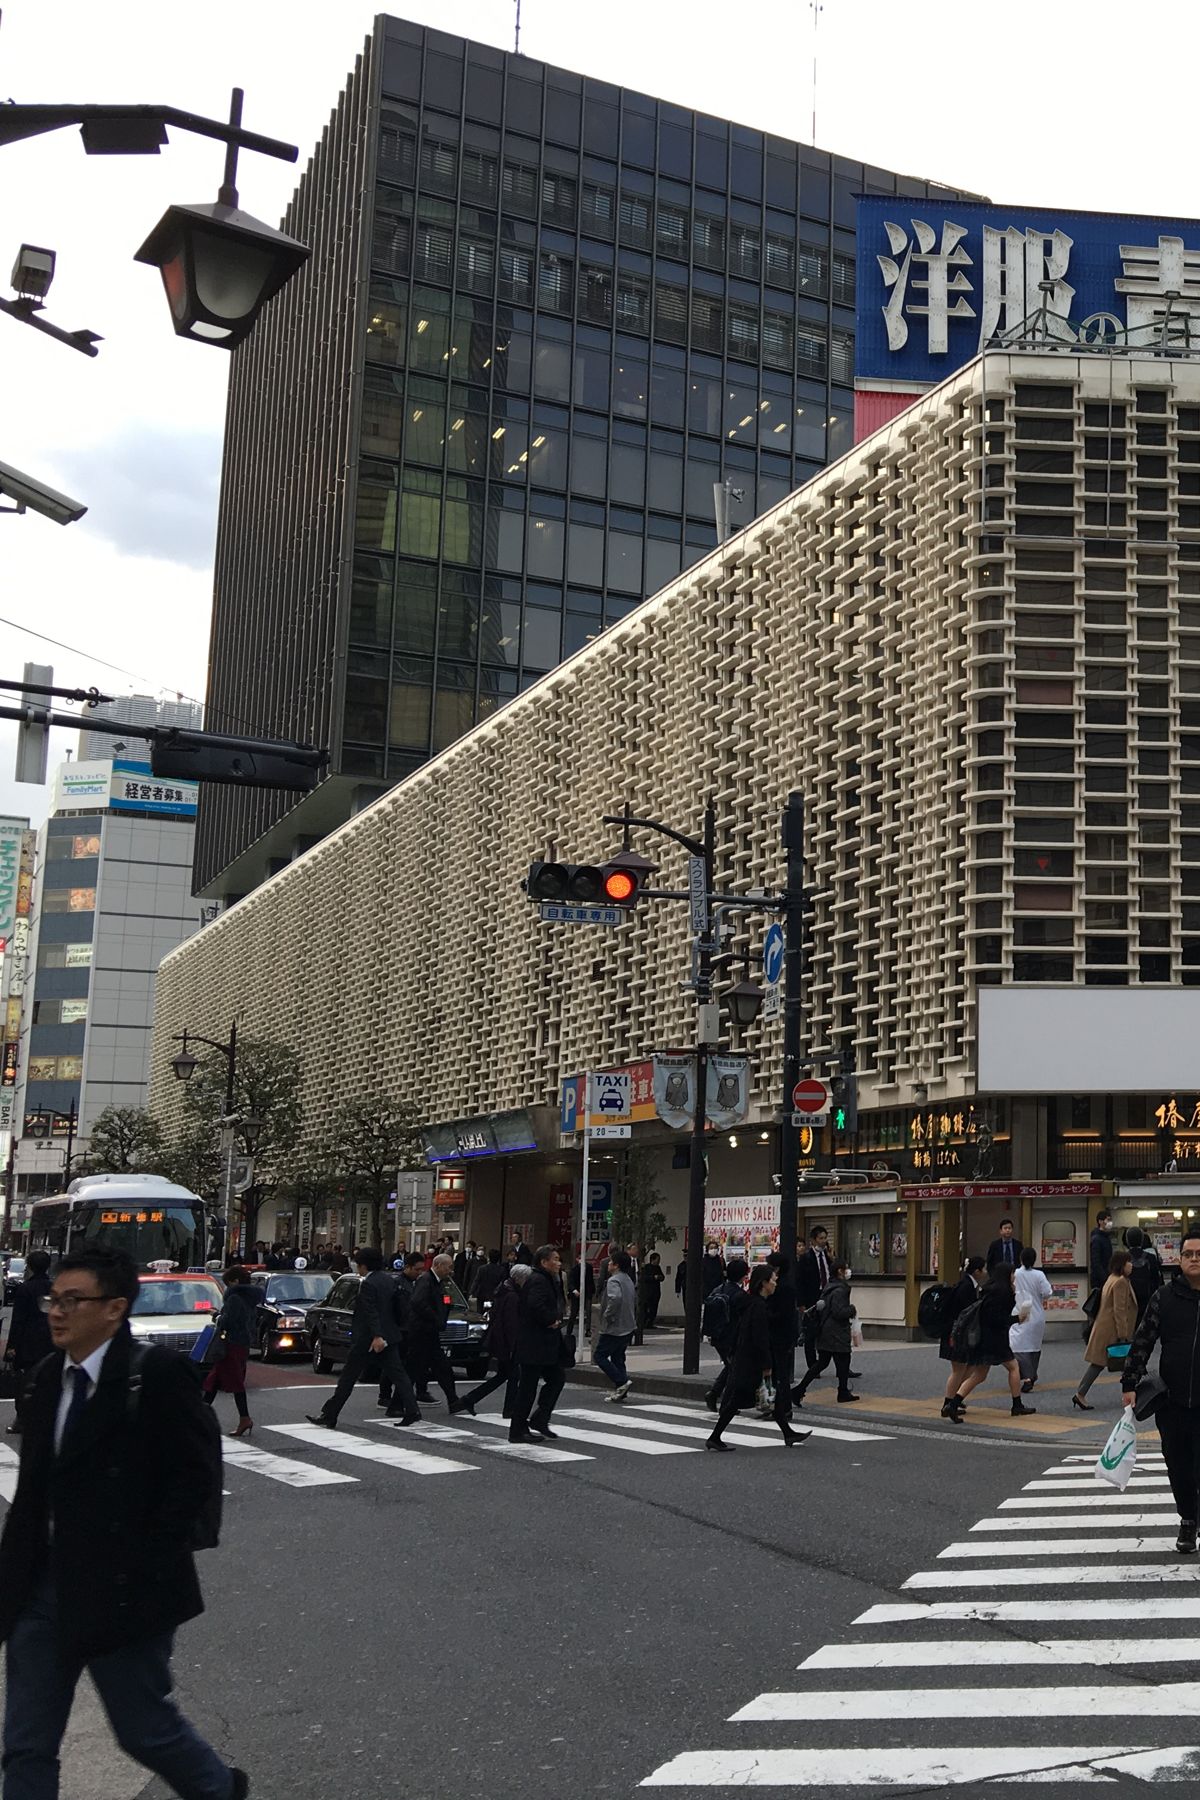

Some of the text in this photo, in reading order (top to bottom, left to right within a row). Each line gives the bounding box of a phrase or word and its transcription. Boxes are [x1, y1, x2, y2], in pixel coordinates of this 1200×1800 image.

[66, 786, 103, 795] FamilyMart
[125, 782, 183, 802] 経営者募集
[692, 860, 705, 929] スクランブル式
[547, 908, 616, 922] 自転車専用
[595, 1075, 628, 1087] TAXI
[564, 1086, 577, 1123] P
[1, 1105, 11, 1126] BAR
[1020, 1186, 1043, 1195] 宝くじ
[1048, 1184, 1095, 1194] ラッキーセンター
[711, 1205, 776, 1222] OPENING SALE!
[358, 1207, 369, 1245] SILVER
